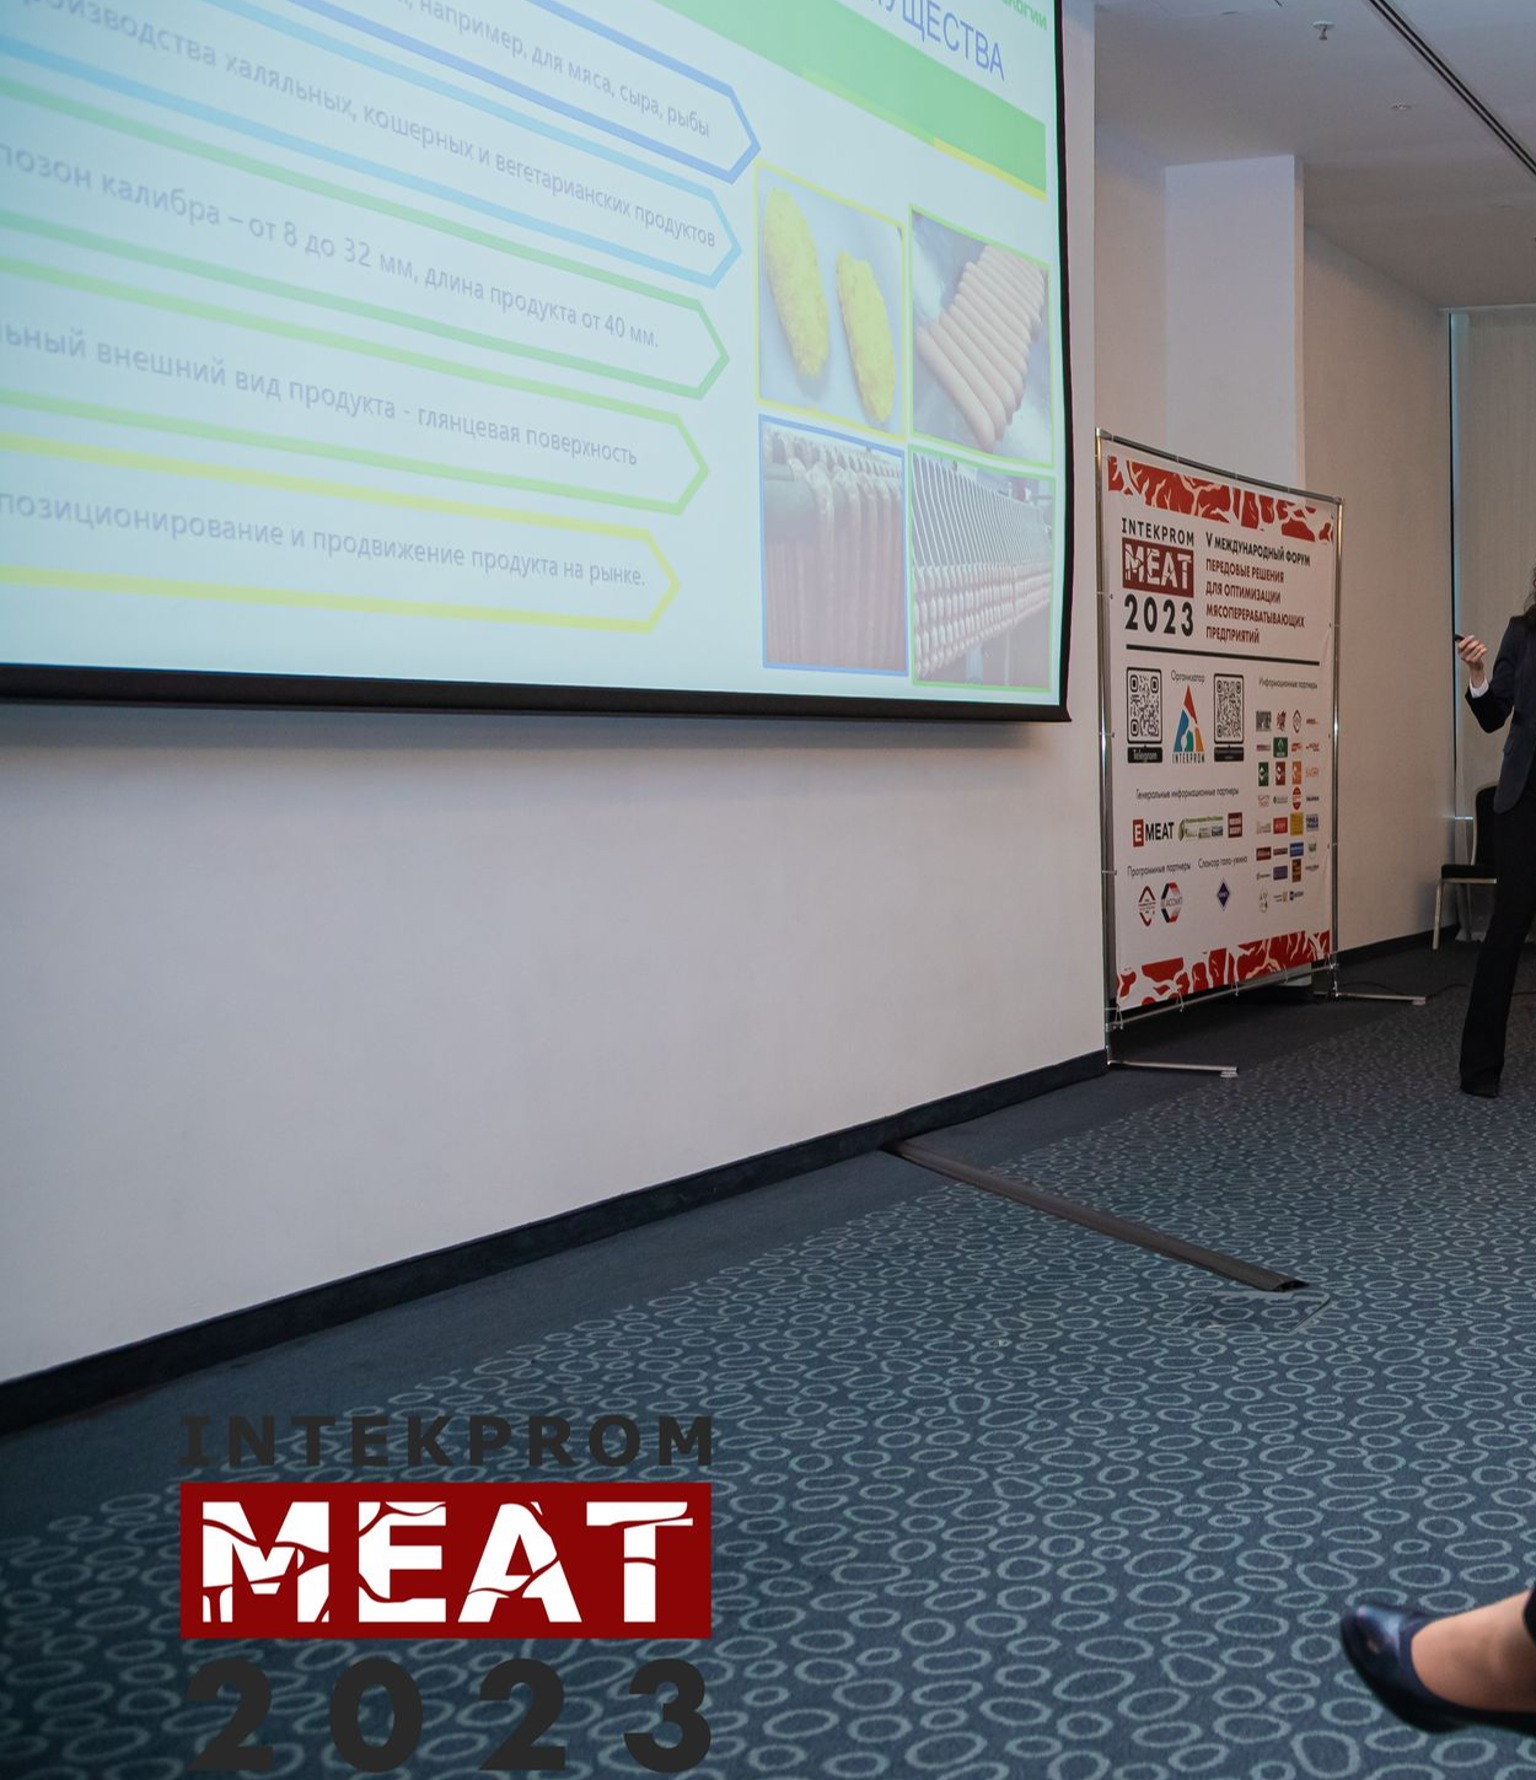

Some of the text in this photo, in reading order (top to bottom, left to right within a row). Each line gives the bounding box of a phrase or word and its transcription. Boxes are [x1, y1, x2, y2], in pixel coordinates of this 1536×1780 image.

[531, 45, 563, 72] для
[568, 62, 616, 98] мяса,
[619, 85, 664, 120] сыра,
[667, 104, 710, 138] рыбы
[225, 52, 358, 123] халяльных,
[364, 104, 474, 159] кошерных
[478, 145, 490, 166] и
[495, 153, 632, 218] вегетарианских
[634, 206, 716, 248] продуктов
[102, 172, 221, 226] калибра
[249, 217, 277, 241] от
[283, 220, 298, 248] 8
[304, 234, 335, 259] до
[344, 237, 372, 268] 32
[379, 254, 419, 285] мм,
[424, 267, 485, 301] длина
[490, 288, 578, 325] продукта
[582, 313, 602, 333] от
[604, 313, 626, 340] 40
[630, 326, 659, 349] мм.
[0, 323, 87, 359] ьный
[97, 342, 226, 387] внешний
[235, 370, 282, 401] вид
[289, 380, 396, 420] продукта
[417, 405, 520, 443] глянцевая
[526, 427, 638, 467] поверхность
[1121, 517, 1194, 547] INTEKPROM
[1205, 532, 1311, 567] V МЕЖДУНАРОДНЫЙ ФОРУМ
[291, 529, 305, 548] и
[313, 531, 465, 566] продвижение
[471, 548, 559, 579] продукта
[563, 557, 584, 579] на
[589, 563, 647, 587] рынке.
[1124, 543, 1192, 590] MEAT
[1206, 558, 1285, 583] ПЕРЕДОВЫЕ РЕШЕНИЯ
[1205, 580, 1281, 604] ДЛЯ ОПТИМИЗАЦИИ
[1124, 593, 1194, 637] 2023
[1206, 604, 1305, 628] МЯСОПЕРЕРАБАТЫВАЮЩИХ
[1206, 625, 1260, 643] ПРЕДПРИЯТИЙ
[1145, 822, 1175, 842] MEAT
